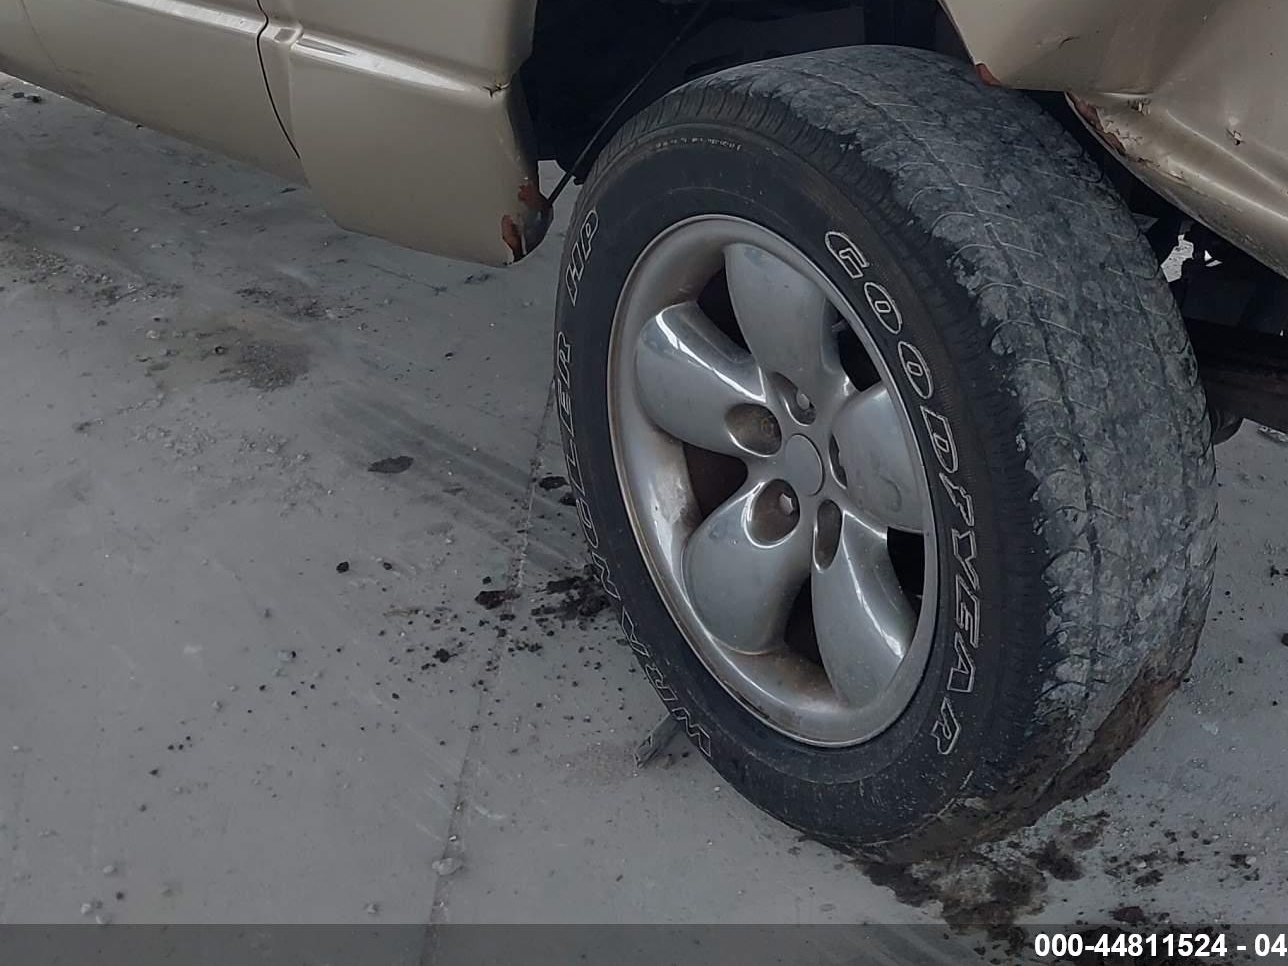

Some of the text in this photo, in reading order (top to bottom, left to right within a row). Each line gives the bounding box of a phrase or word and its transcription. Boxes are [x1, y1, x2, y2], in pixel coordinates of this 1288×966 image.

[554, 209, 711, 757] WRANGLER HP
[824, 231, 981, 755] GOODYEAR
